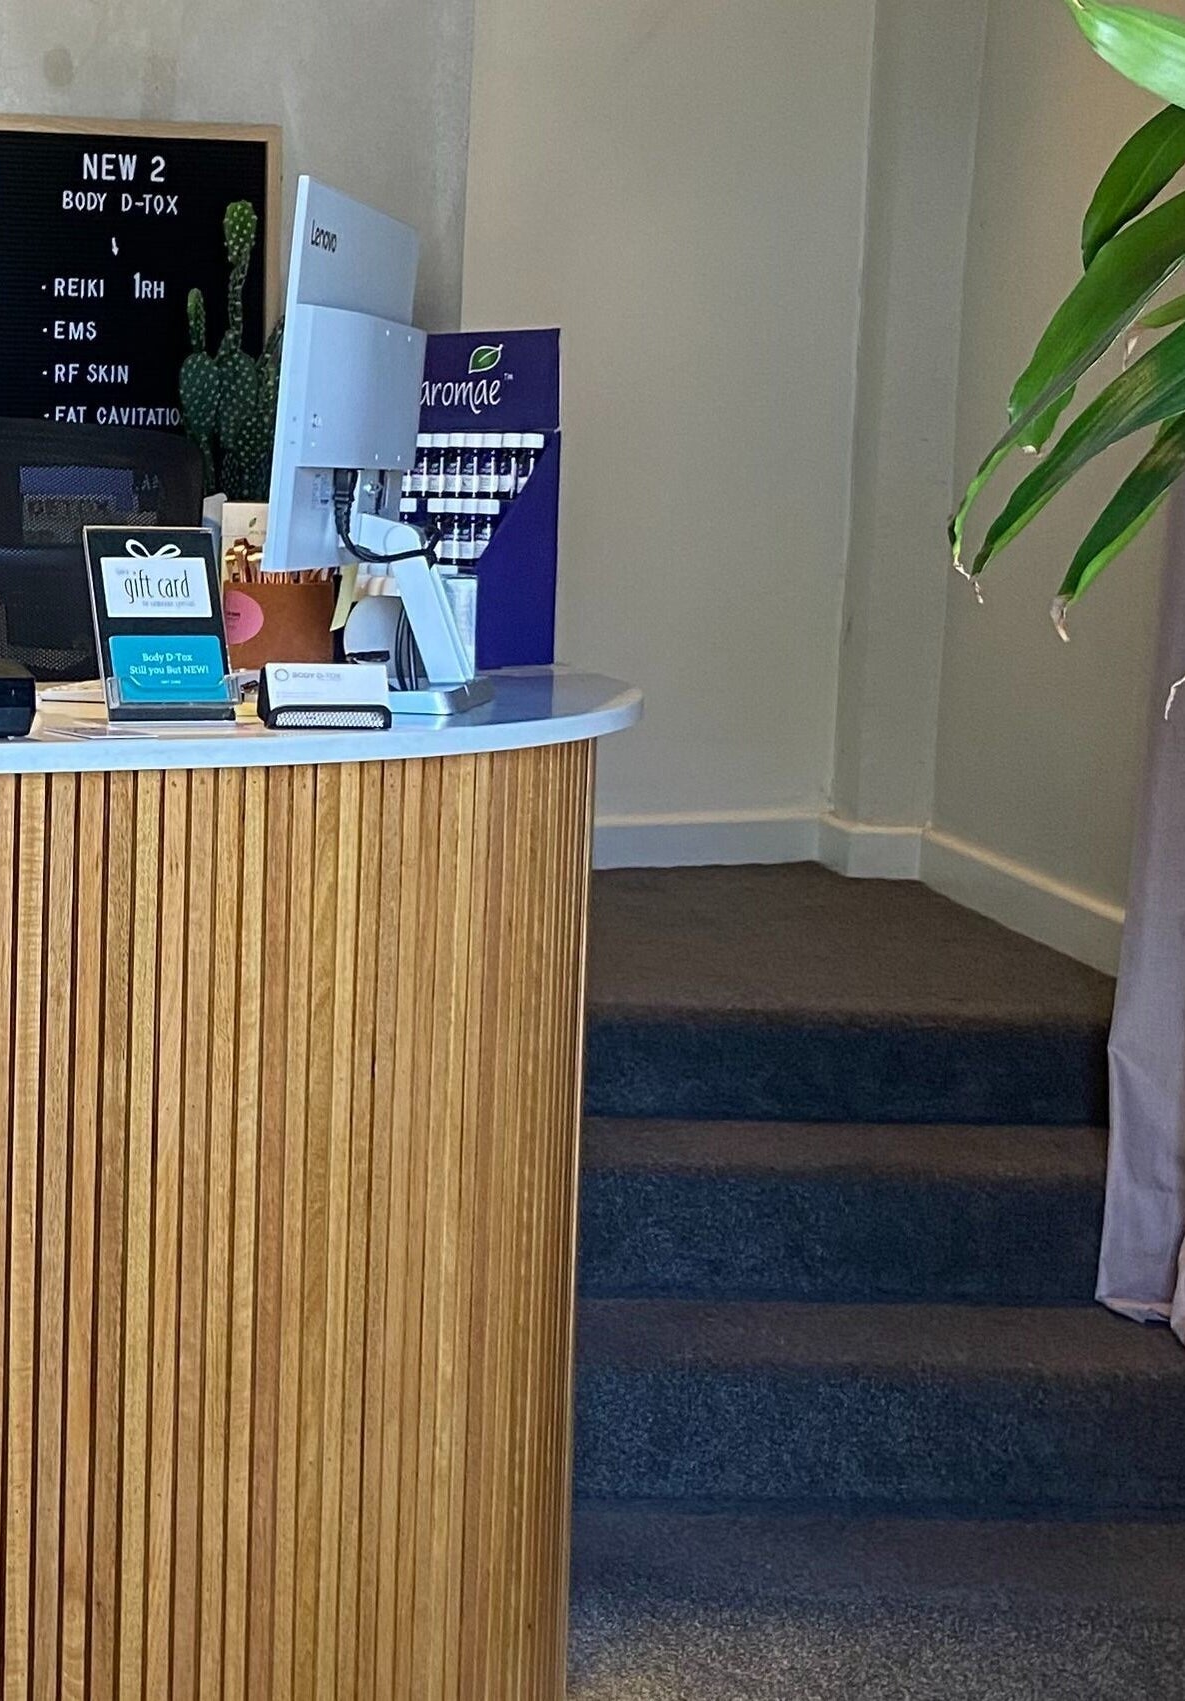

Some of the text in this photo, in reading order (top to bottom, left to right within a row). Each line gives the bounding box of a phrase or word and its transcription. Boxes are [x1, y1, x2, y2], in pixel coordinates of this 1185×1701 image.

[83, 153, 166, 182] NEW 2
[62, 190, 179, 216] BODY D-TOX
[311, 219, 337, 253] Lenovo
[54, 278, 105, 299] REIKI
[54, 320, 97, 341] EMS
[54, 363, 129, 384] RF SKIN
[419, 379, 501, 415] aromae
[55, 405, 181, 426] FAT CAVITATIO
[124, 569, 191, 604] gift card
[142, 653, 165, 664] Body
[129, 665, 210, 676] Still you But NEW!
